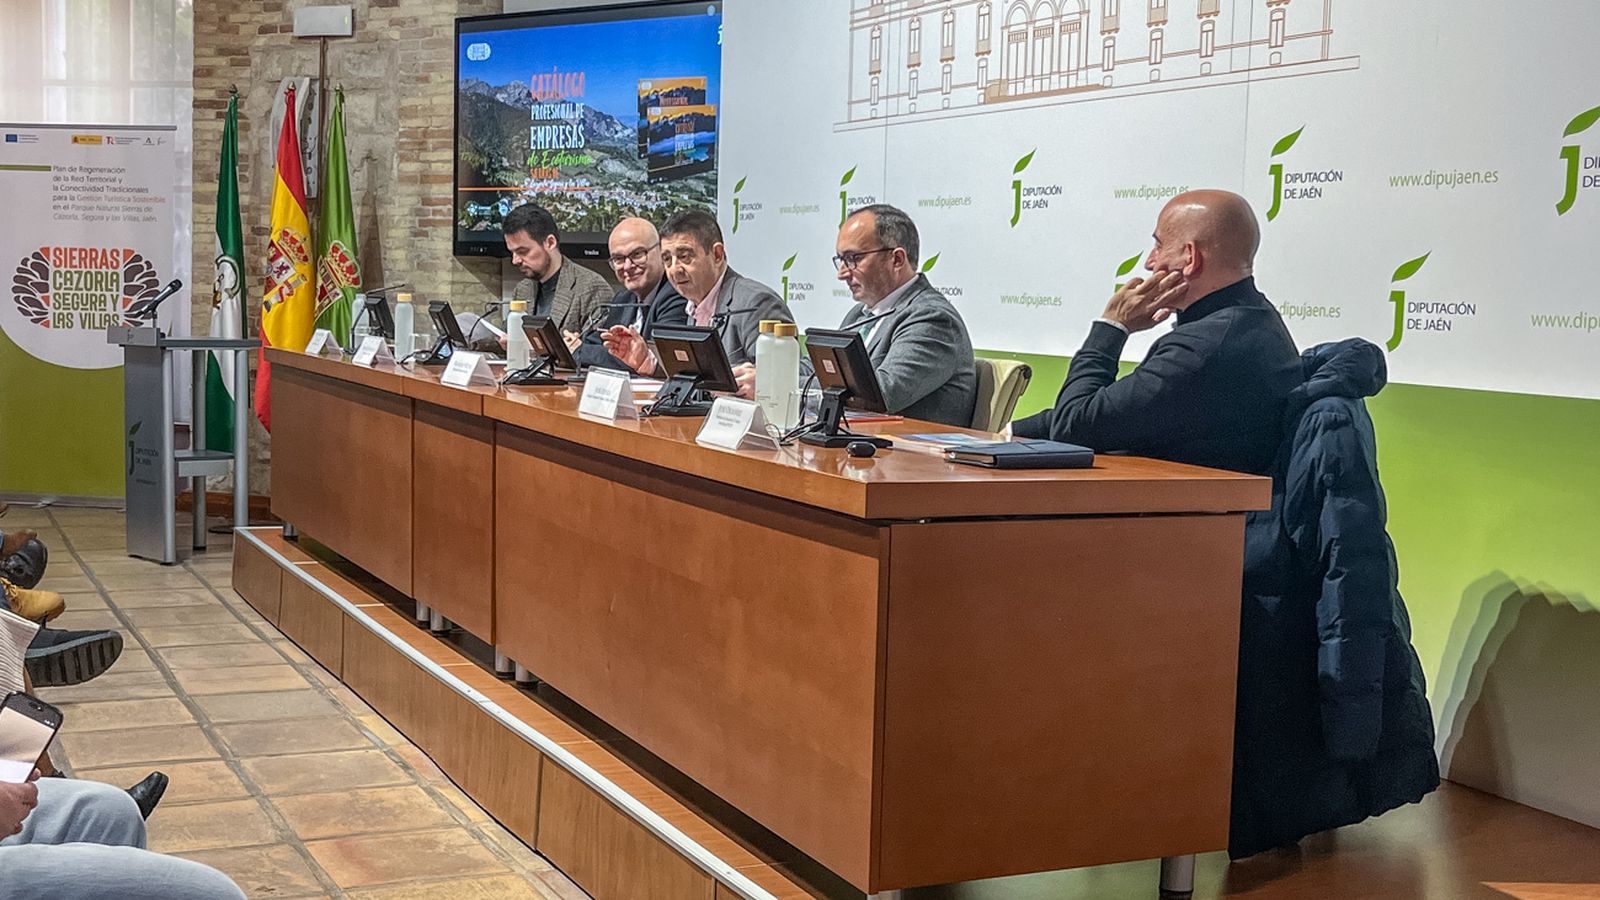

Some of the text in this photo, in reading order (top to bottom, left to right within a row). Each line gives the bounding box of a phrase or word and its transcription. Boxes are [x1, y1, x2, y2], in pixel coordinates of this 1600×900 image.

[530, 122, 585, 149] EMPRESAS
[527, 150, 539, 167] de
[78, 165, 126, 174] Regeneración
[1285, 169, 1343, 184] DIPUTACIÓN
[86, 175, 117, 183] Territorial
[1389, 169, 1499, 190] www.dipujaen.es
[59, 185, 104, 193] Conectividad
[106, 185, 149, 193] Tradicionales
[1022, 185, 1062, 197] DIPUTACIÓN
[1114, 184, 1190, 201] www.dipujaenes
[1284, 186, 1322, 200] DE JAÉN
[847, 195, 876, 206] DIPUTACIÓN
[918, 195, 972, 209] www.dipujaen.es
[1022, 198, 1049, 209] DE JAÉN
[96, 204, 120, 212] Natural
[52, 247, 120, 270] SIERRAS
[52, 270, 120, 292] CAZORLA
[935, 287, 963, 296] UTACIÓN
[52, 292, 119, 312] SEGURA Y
[1000, 292, 1062, 309] www.dipujaen.es
[1408, 301, 1476, 315] DIPUTACIÓN
[52, 312, 120, 330] LAS VILLAS
[1407, 317, 1452, 331] DE JAÉN
